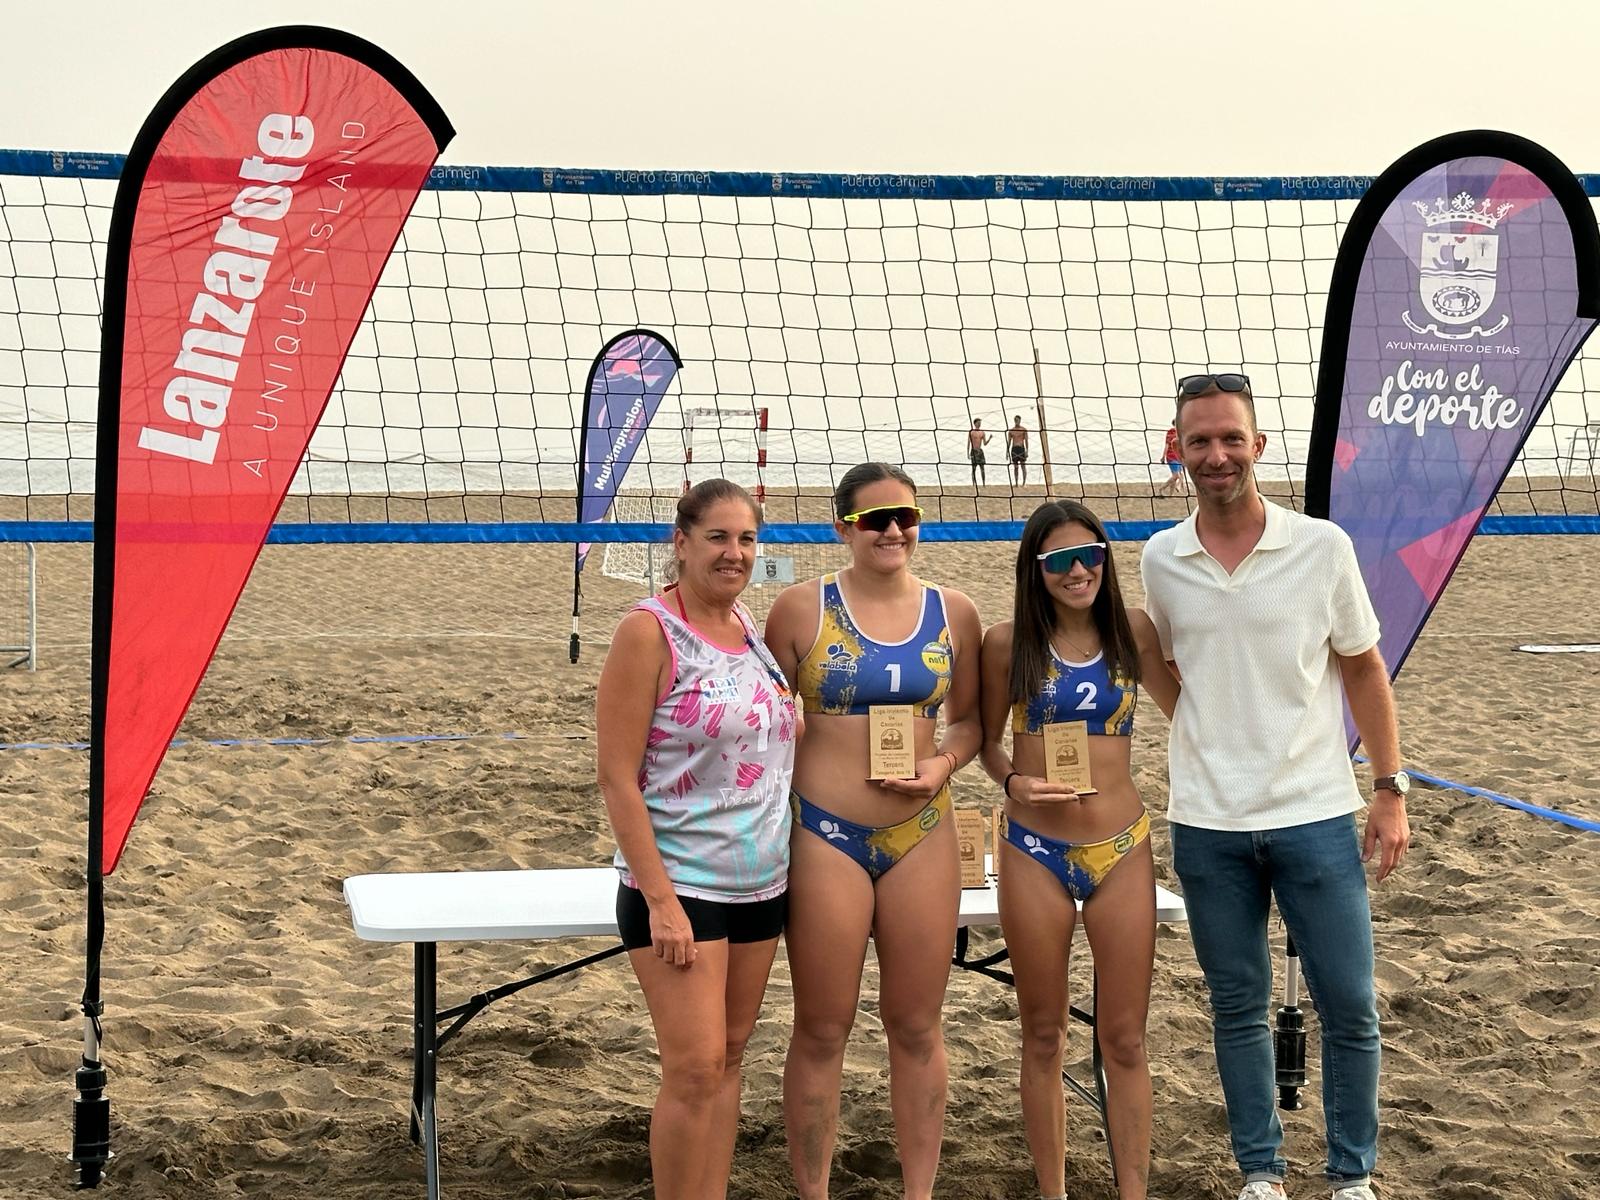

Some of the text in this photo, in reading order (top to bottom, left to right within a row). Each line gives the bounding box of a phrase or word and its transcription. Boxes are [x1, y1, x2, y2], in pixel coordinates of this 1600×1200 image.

[137, 113, 315, 465] Lanzarote
[242, 121, 365, 477] A UNIQUE ISLAND
[1385, 341, 1520, 355] AYUNTAMIENTO DE TÍAS
[1396, 360, 1484, 392] Con el
[1368, 375, 1524, 437] deporte
[884, 664, 901, 692] 1
[1075, 682, 1097, 710] 2
